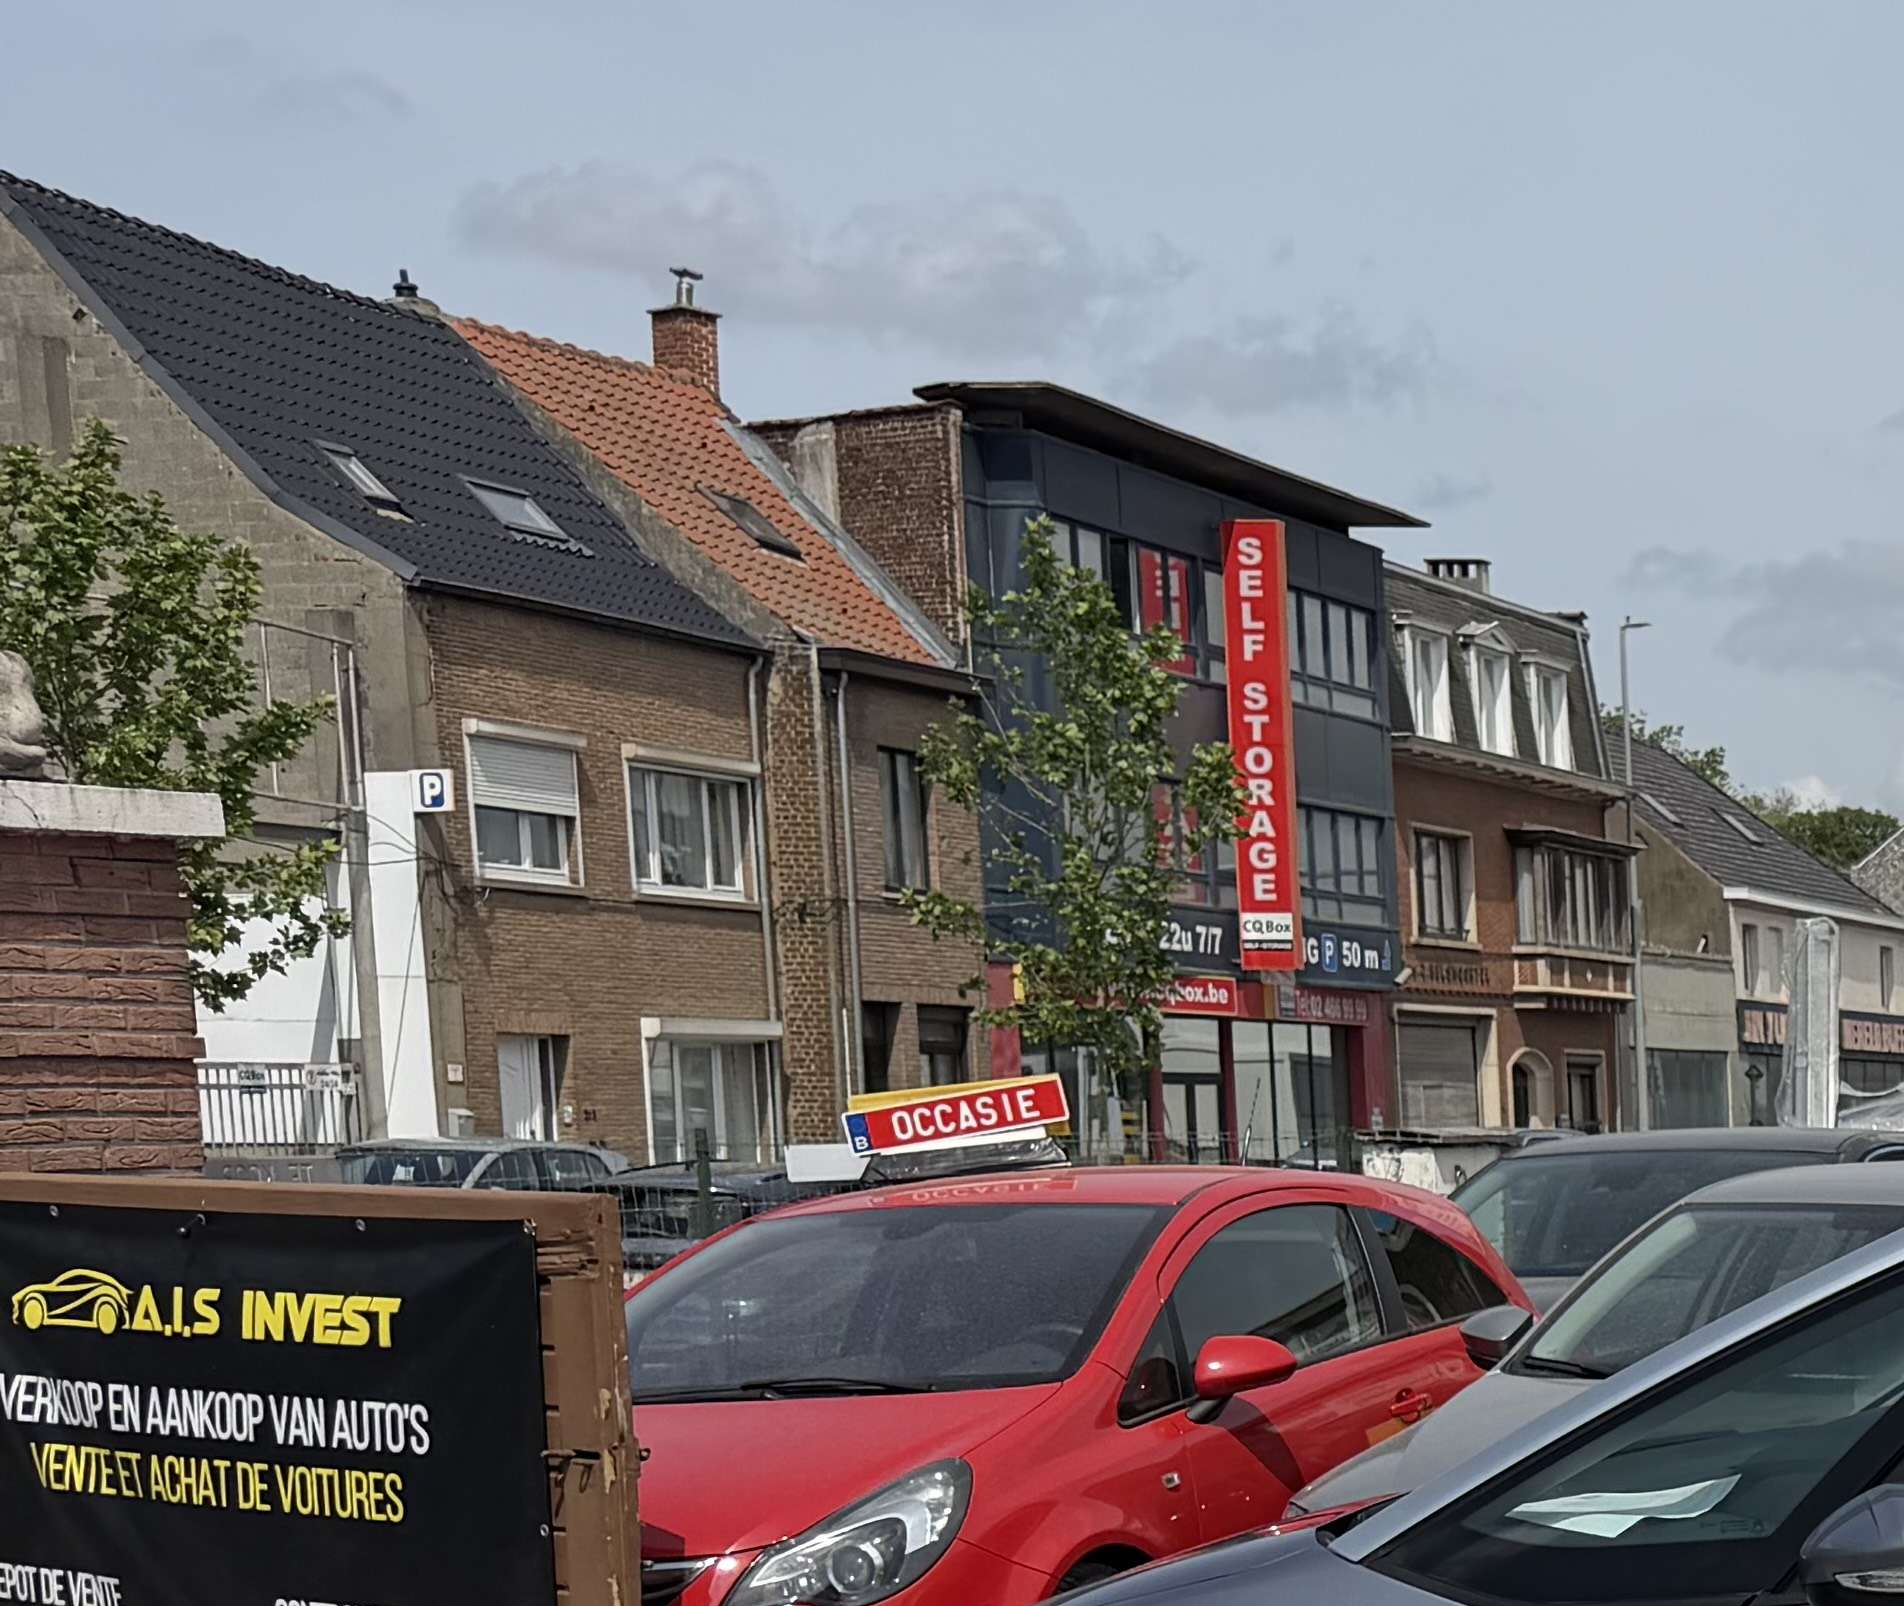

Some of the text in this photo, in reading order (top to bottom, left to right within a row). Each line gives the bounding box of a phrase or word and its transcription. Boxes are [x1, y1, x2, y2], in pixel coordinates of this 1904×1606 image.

[1237, 536, 1266, 663] SELF
[422, 775, 442, 806] P
[1243, 682, 1278, 901] STORAGE
[1195, 925, 1223, 955] 7/7
[1342, 943, 1361, 967] 50
[1364, 951, 1380, 968] m
[891, 1088, 1040, 1140] OCCASIE
[855, 1136, 868, 1150] B
[242, 1290, 402, 1347] INVEST
[0, 1373, 430, 1455] VERKOOP EN AANKOOP VAN AUTO'S
[30, 1441, 404, 1522] VENTE ET ACHAT DE VOITURES
[0, 1563, 38, 1603] EPOT
[39, 1567, 66, 1606] DE
